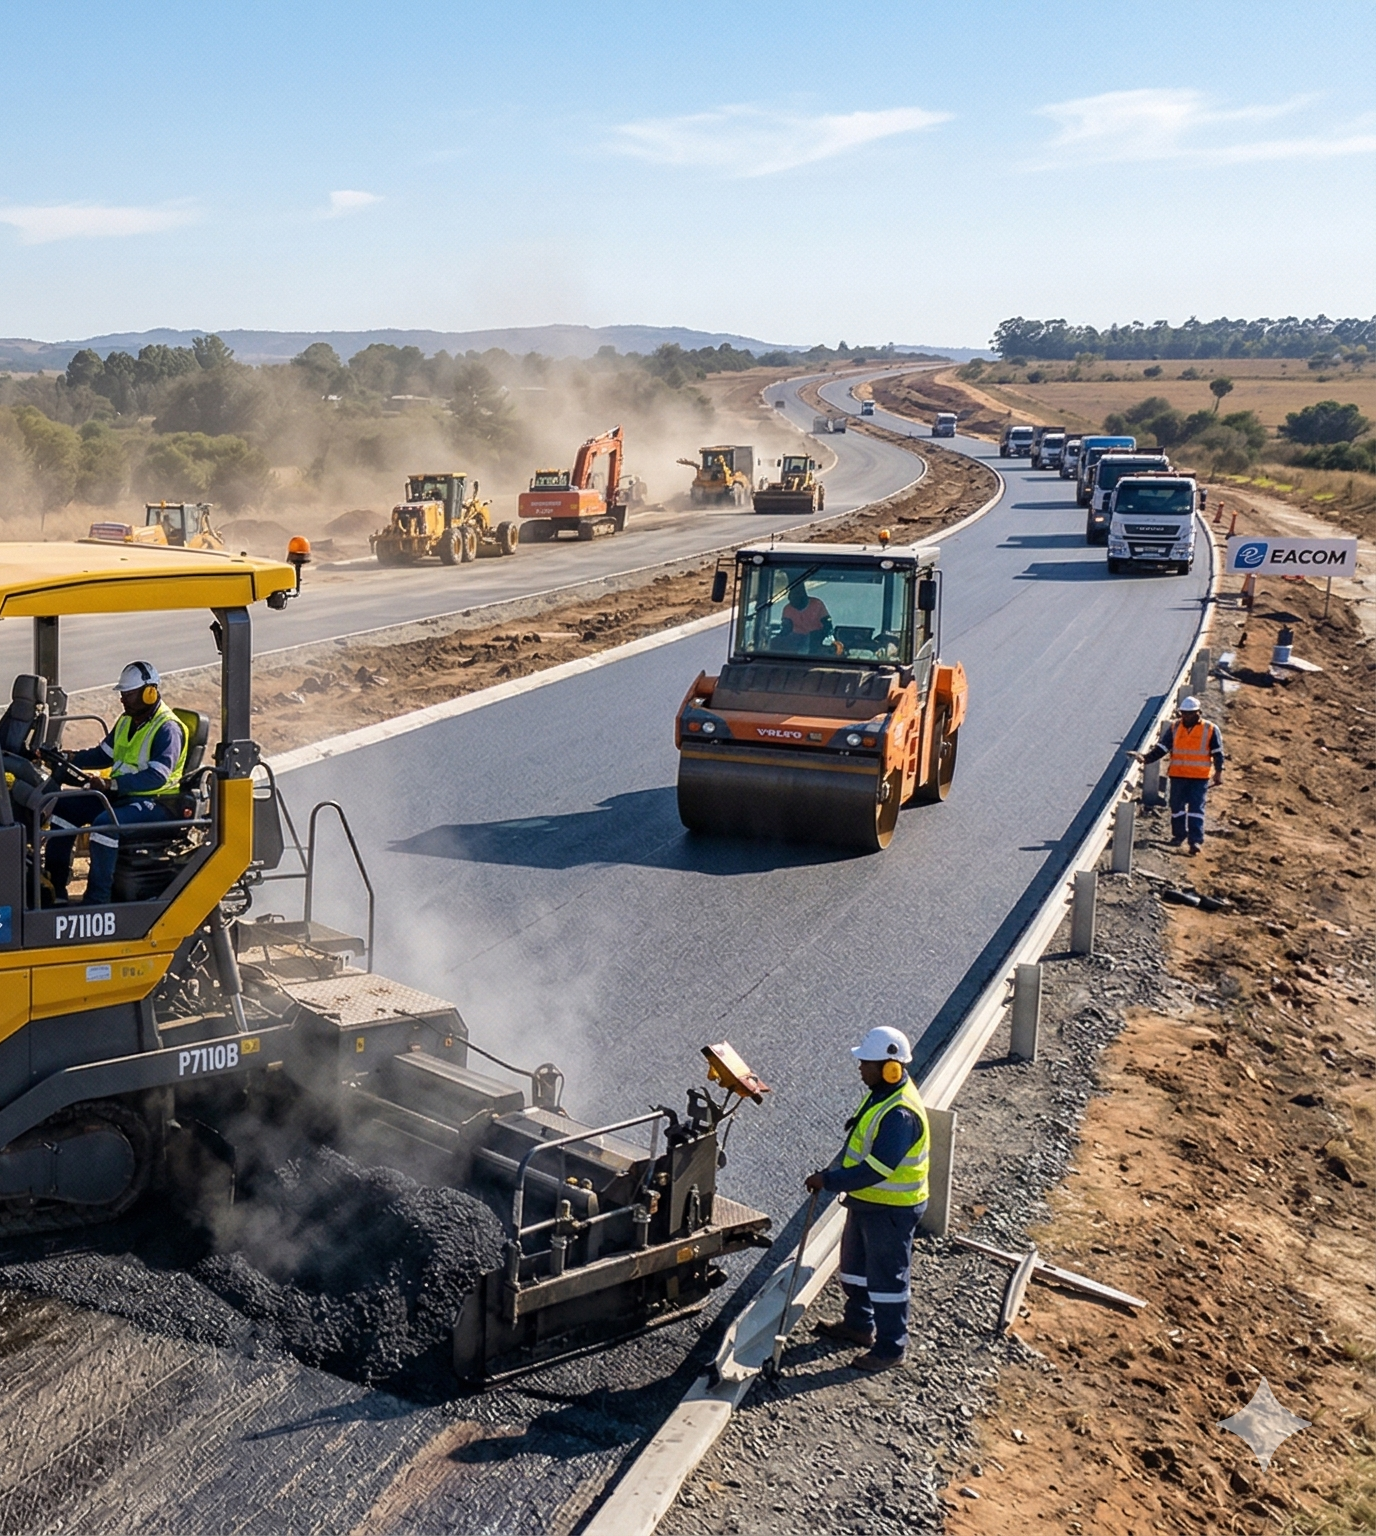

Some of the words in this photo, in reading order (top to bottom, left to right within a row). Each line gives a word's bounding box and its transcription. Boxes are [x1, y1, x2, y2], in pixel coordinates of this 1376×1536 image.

[1269, 549, 1347, 565] EACOM
[55, 912, 116, 940] P7110B
[178, 1042, 239, 1076] P7110B
